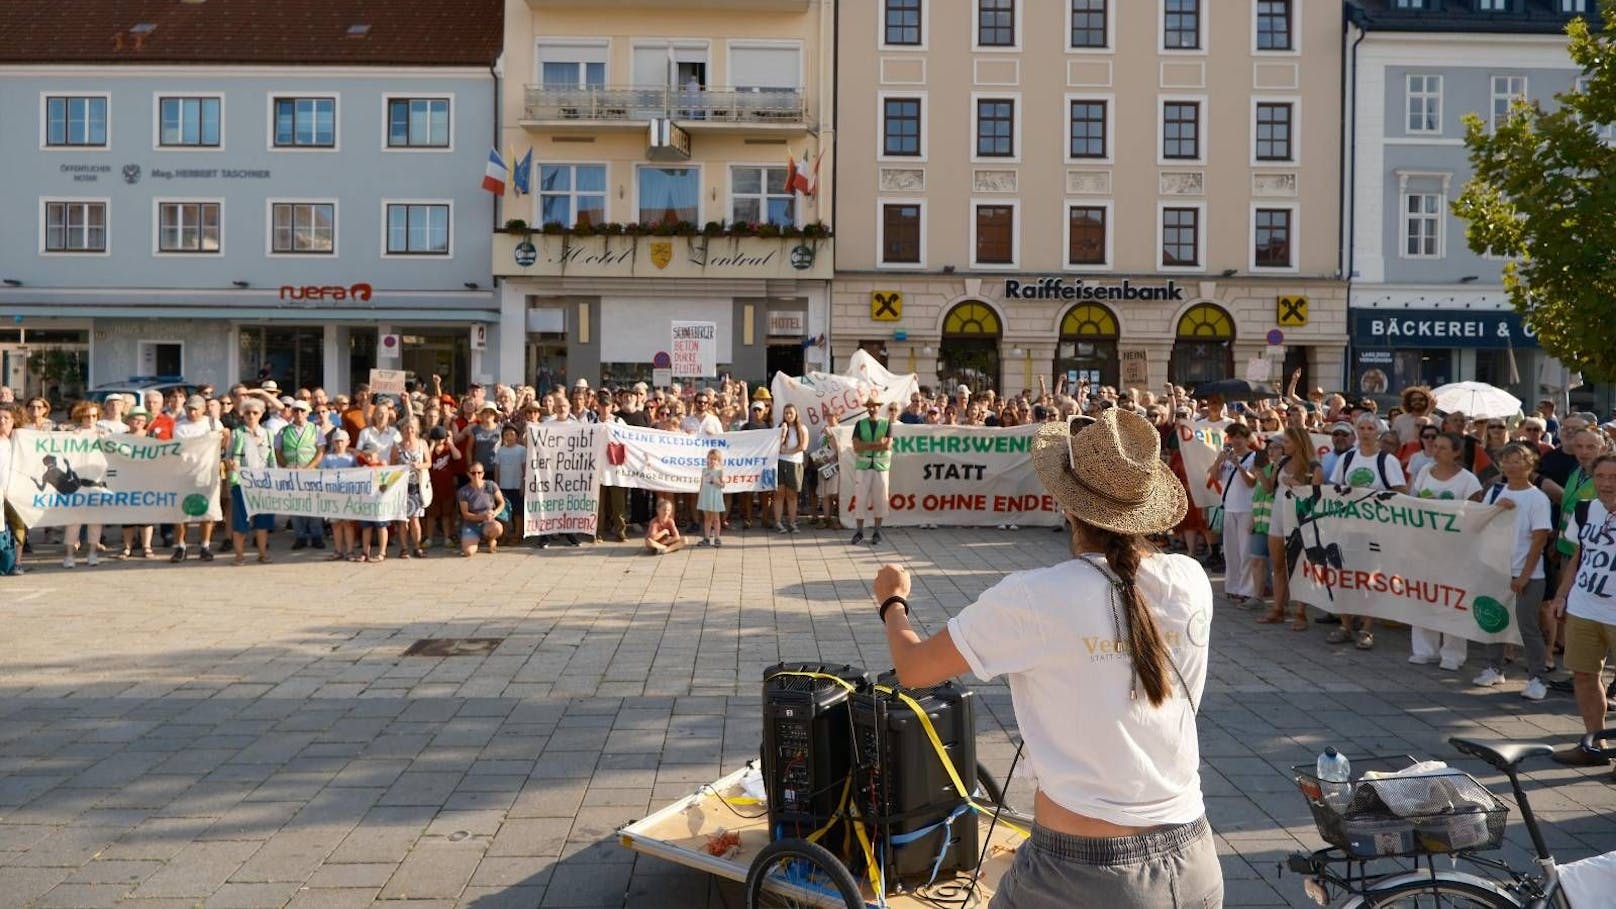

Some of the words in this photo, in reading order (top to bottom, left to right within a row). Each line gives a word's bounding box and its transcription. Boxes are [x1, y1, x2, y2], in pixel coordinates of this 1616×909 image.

[280, 285, 347, 301] ruefa
[1005, 279, 1182, 301] Raiffeisenbank
[770, 316, 802, 330] HOTEL
[1371, 317, 1485, 336] BÄCKEREI
[1496, 322, 1510, 337] &
[529, 428, 565, 448] Wer
[567, 428, 594, 453] gibt
[613, 430, 657, 445] KLEINE
[35, 437, 182, 460] KLIMASCHUTZ
[531, 452, 552, 470] der
[556, 452, 597, 471] Politik
[240, 470, 273, 489] Stadt
[275, 471, 294, 491] und
[296, 471, 323, 491] Land
[923, 463, 987, 481] STATT
[529, 474, 550, 493] das
[555, 473, 594, 493] Recht
[33, 490, 178, 508] KINDERRECHT
[244, 489, 313, 513] Widerstand
[526, 498, 565, 513] unsere
[923, 494, 987, 512] OHNE
